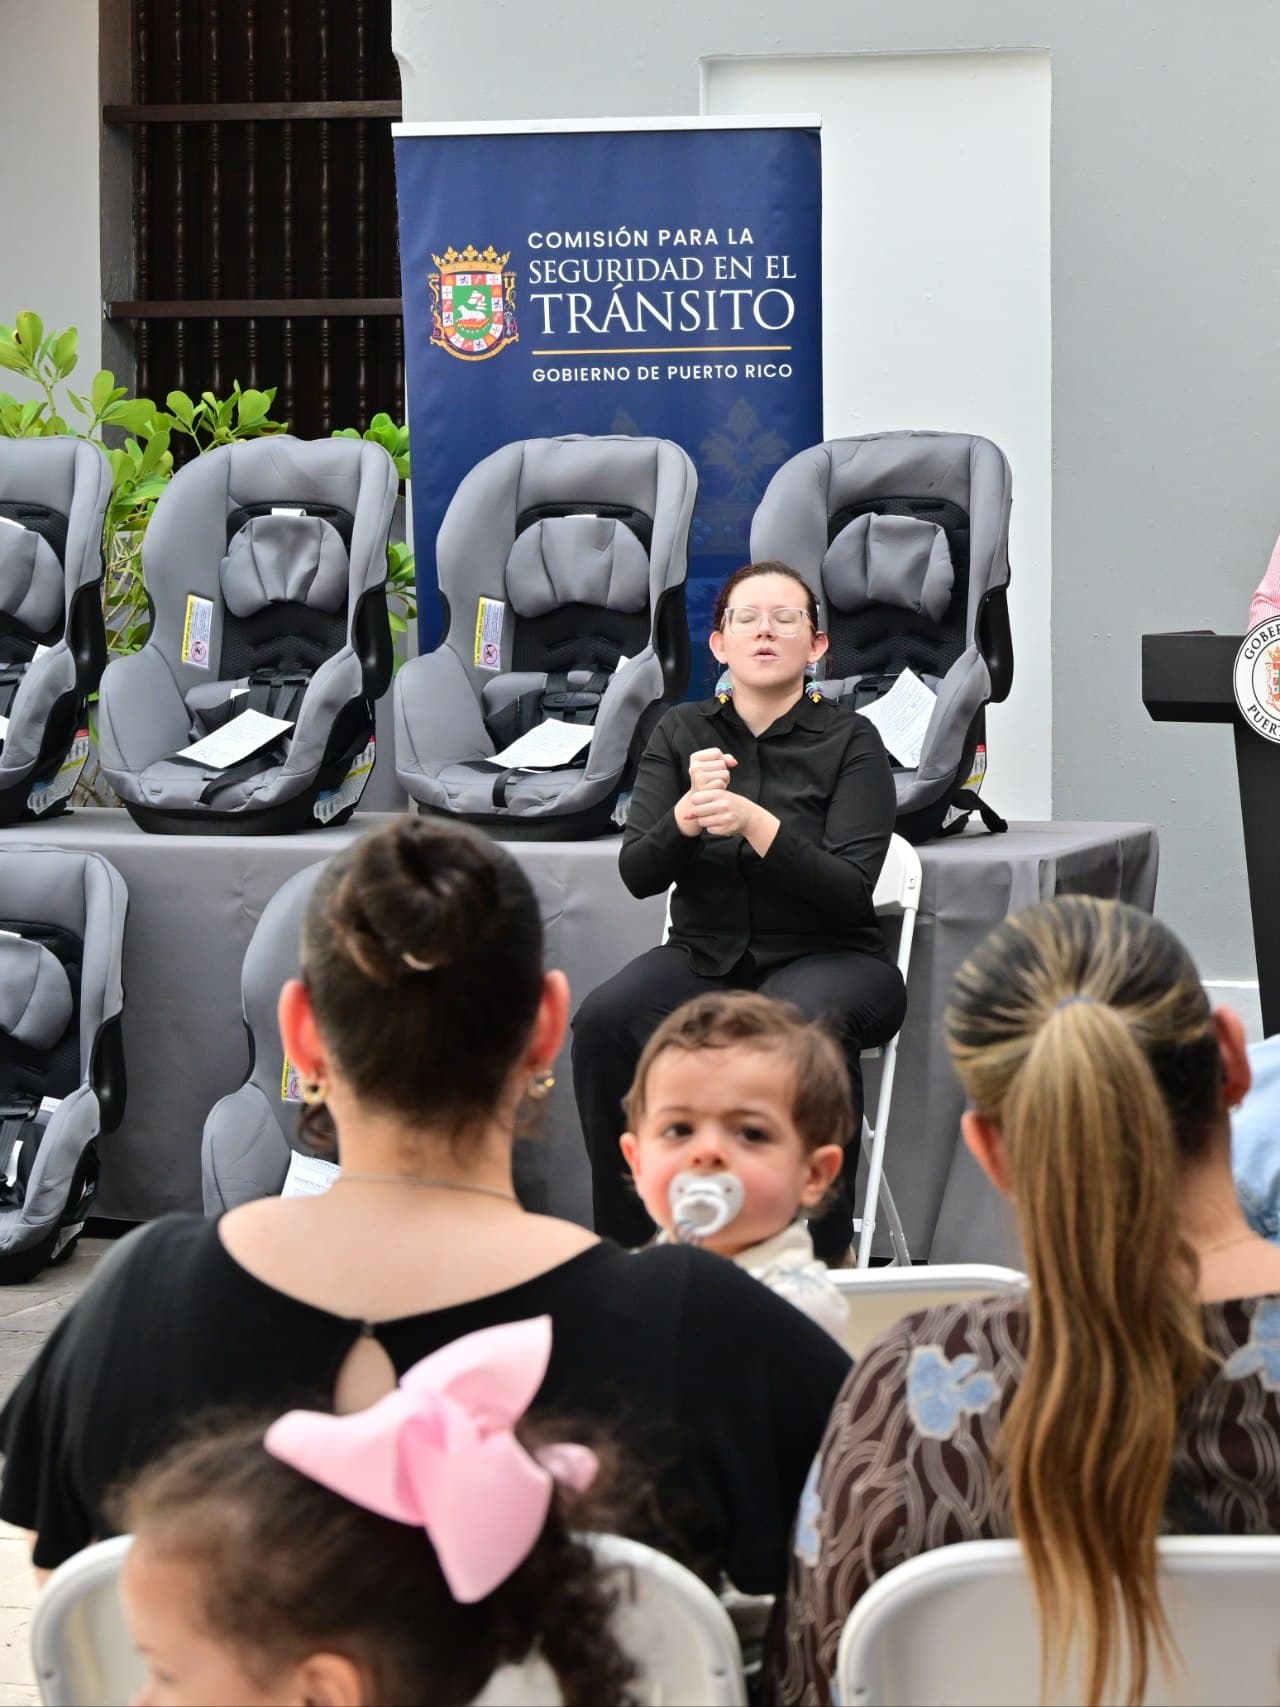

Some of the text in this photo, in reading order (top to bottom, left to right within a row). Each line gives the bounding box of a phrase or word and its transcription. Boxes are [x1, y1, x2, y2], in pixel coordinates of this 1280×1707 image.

[527, 225, 754, 249] COMISIÓN PARA LA
[529, 255, 797, 284] SEGURIDAD EN EL
[530, 283, 796, 335] TRÁNSITO
[532, 363, 793, 383] GOBIERNO DE PUERTO RICO
